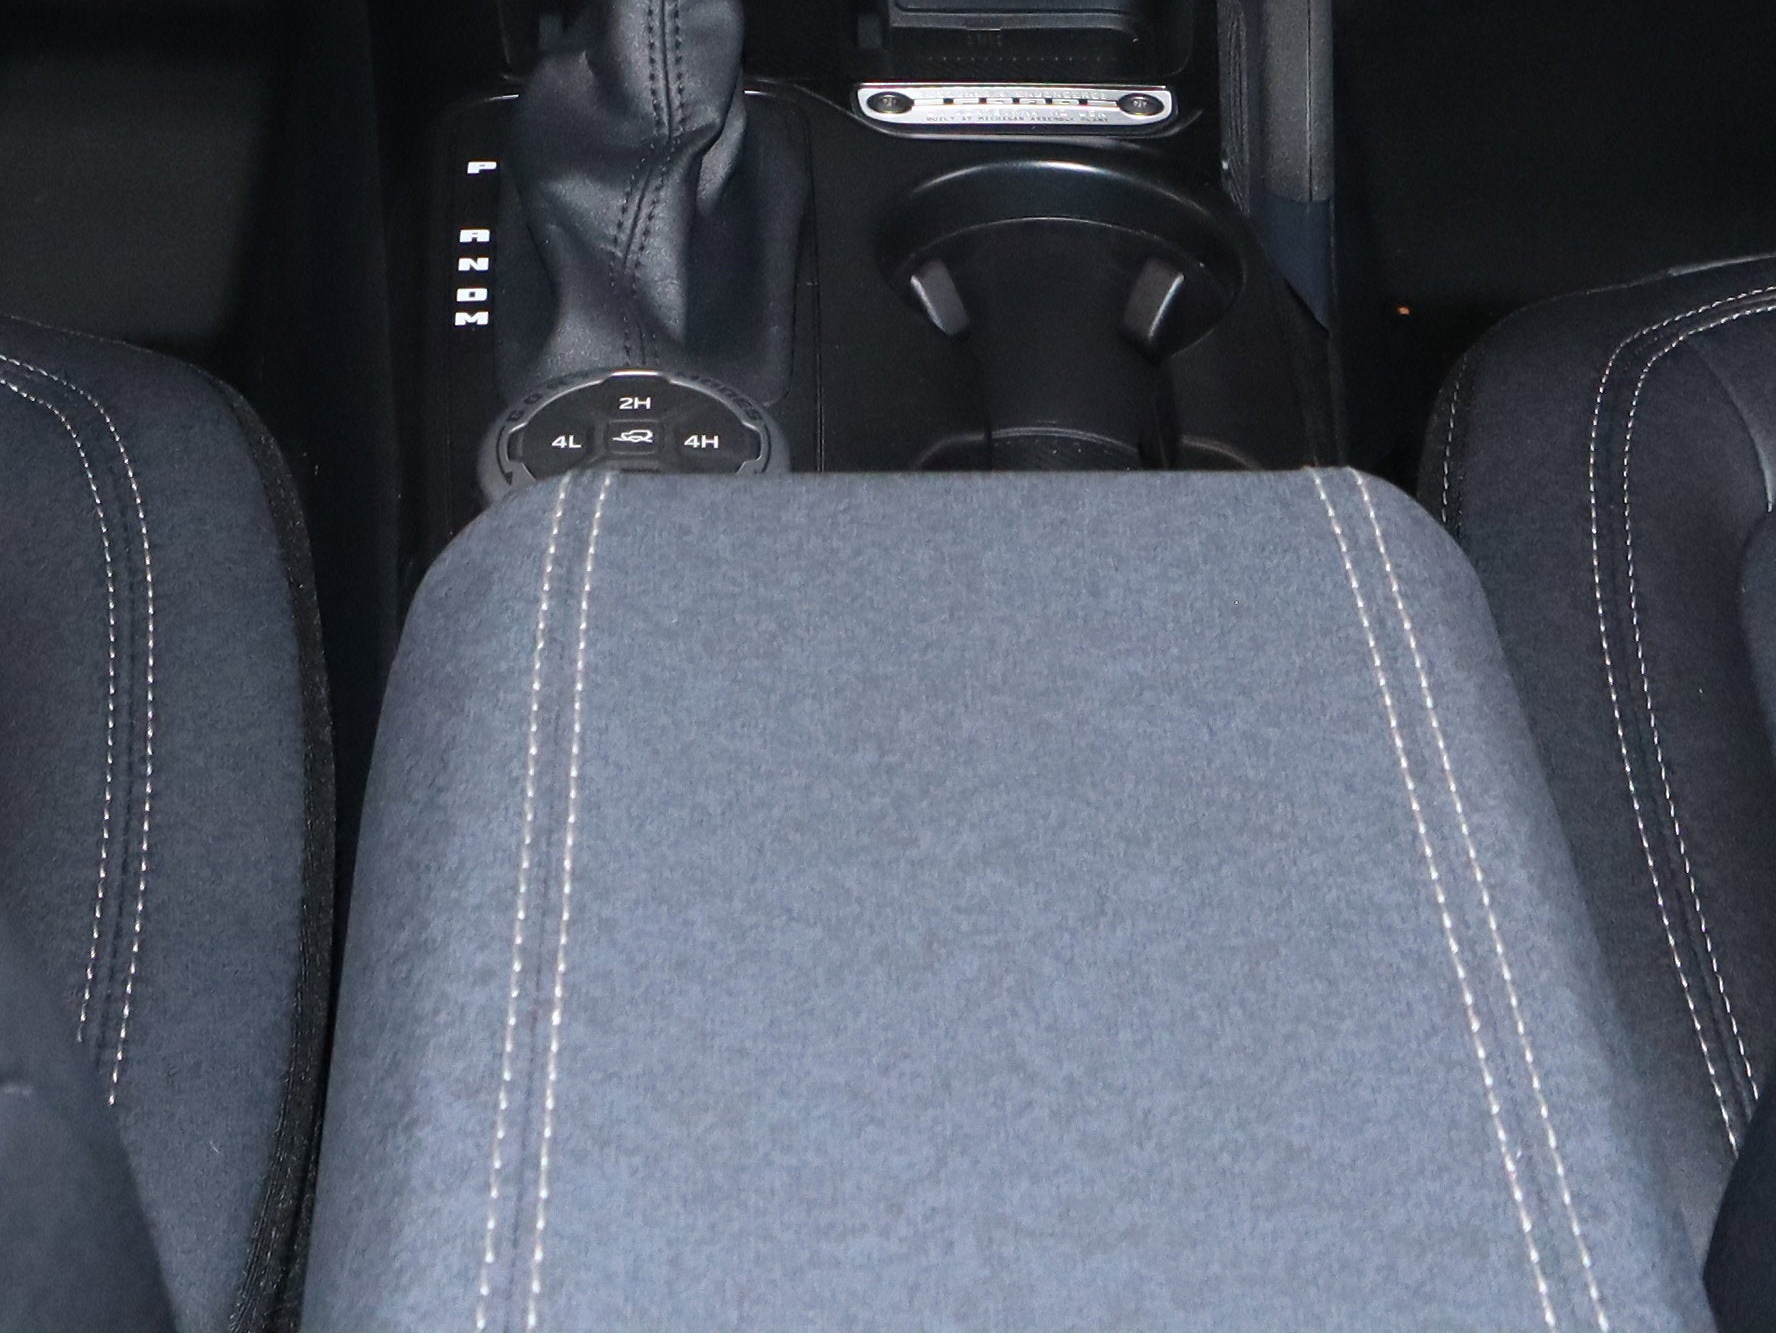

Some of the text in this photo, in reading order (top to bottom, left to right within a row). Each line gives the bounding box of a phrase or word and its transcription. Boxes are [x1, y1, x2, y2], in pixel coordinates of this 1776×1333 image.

[467, 161, 497, 173] P
[458, 258, 489, 270] N
[454, 312, 488, 325] M
[619, 397, 651, 410] 2H
[551, 435, 582, 448] 4L
[684, 435, 719, 448] 4H
